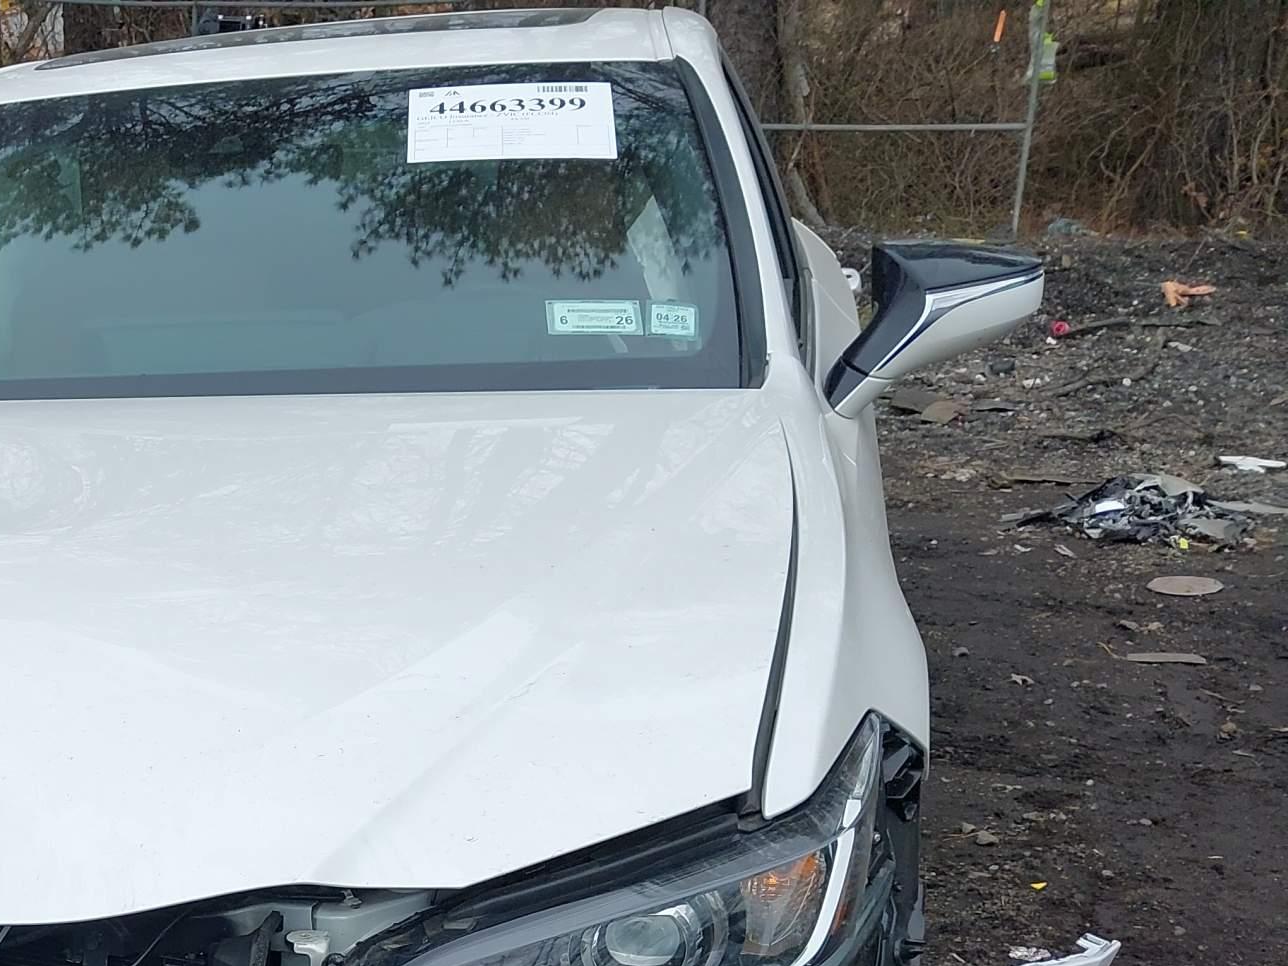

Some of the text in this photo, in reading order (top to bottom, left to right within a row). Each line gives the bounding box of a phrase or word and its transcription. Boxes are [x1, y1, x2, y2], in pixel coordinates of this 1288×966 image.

[430, 97, 586, 114] 44663399
[559, 315, 569, 326] 6
[615, 315, 634, 326] 26
[656, 312, 688, 324] 04 26
